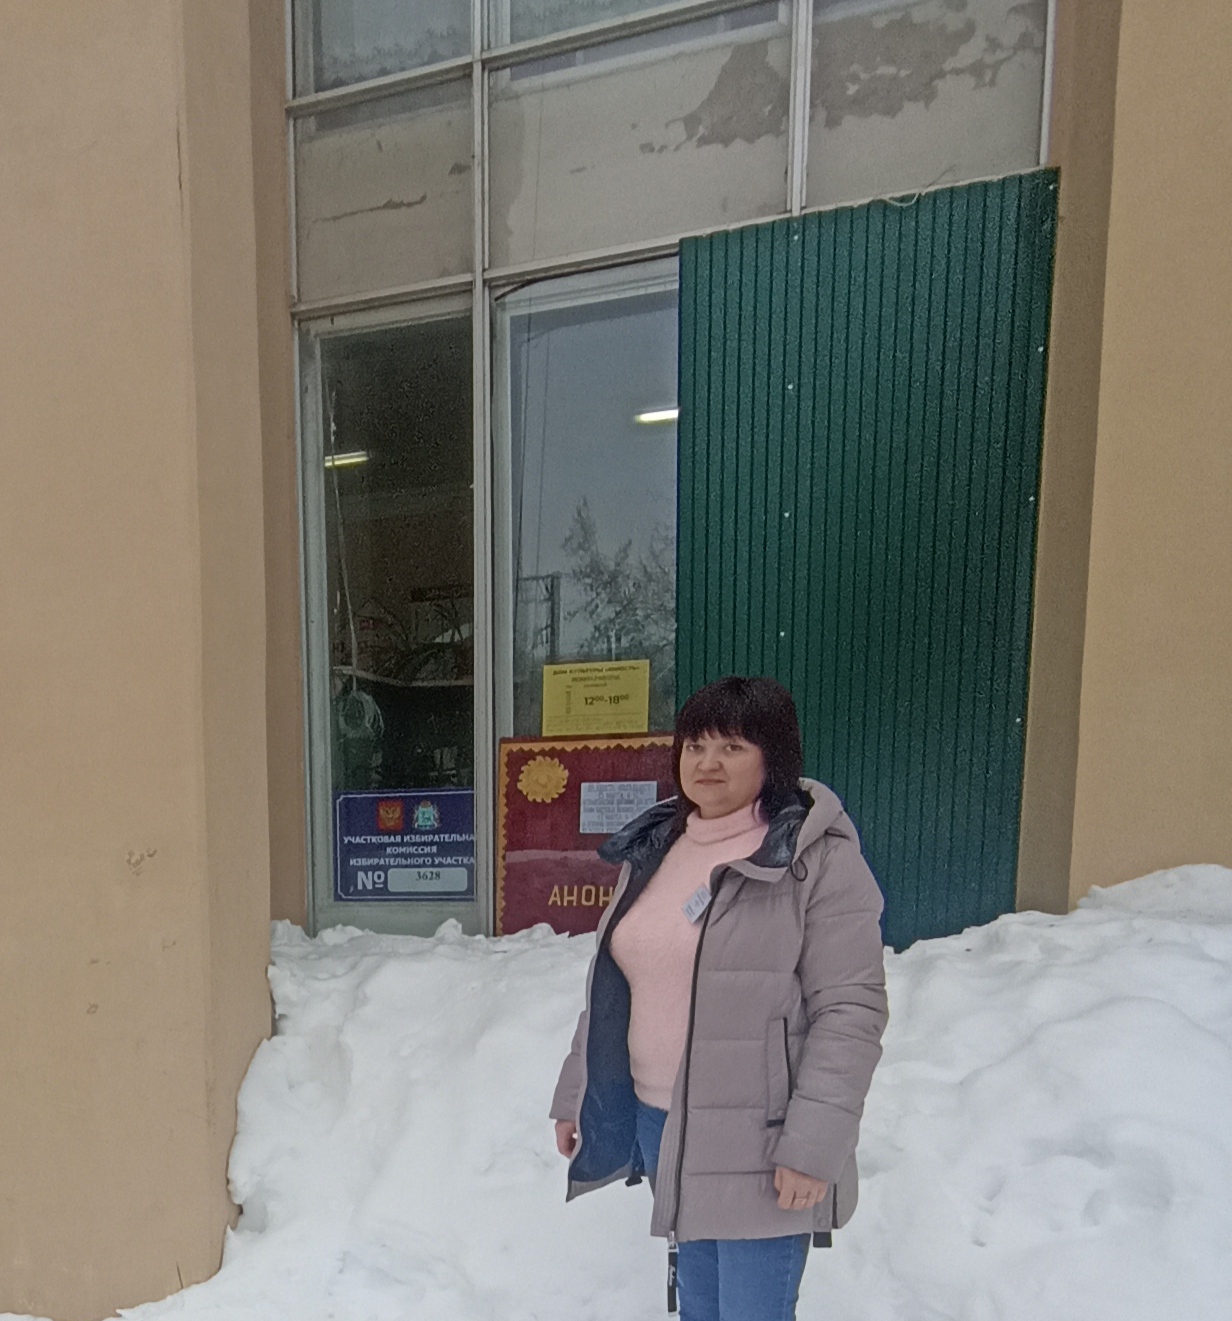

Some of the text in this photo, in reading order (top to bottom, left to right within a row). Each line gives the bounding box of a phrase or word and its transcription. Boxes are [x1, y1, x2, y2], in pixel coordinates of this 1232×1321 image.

[343, 835, 401, 844] УЧАСТКОВАЯ
[386, 845, 437, 854] КОМИССИЯ
[349, 856, 475, 867] ИЗБИРАТЕЛЬНОГО УЧАСТКА
[357, 871, 441, 890] № 3628
[548, 884, 613, 907] АНОН
